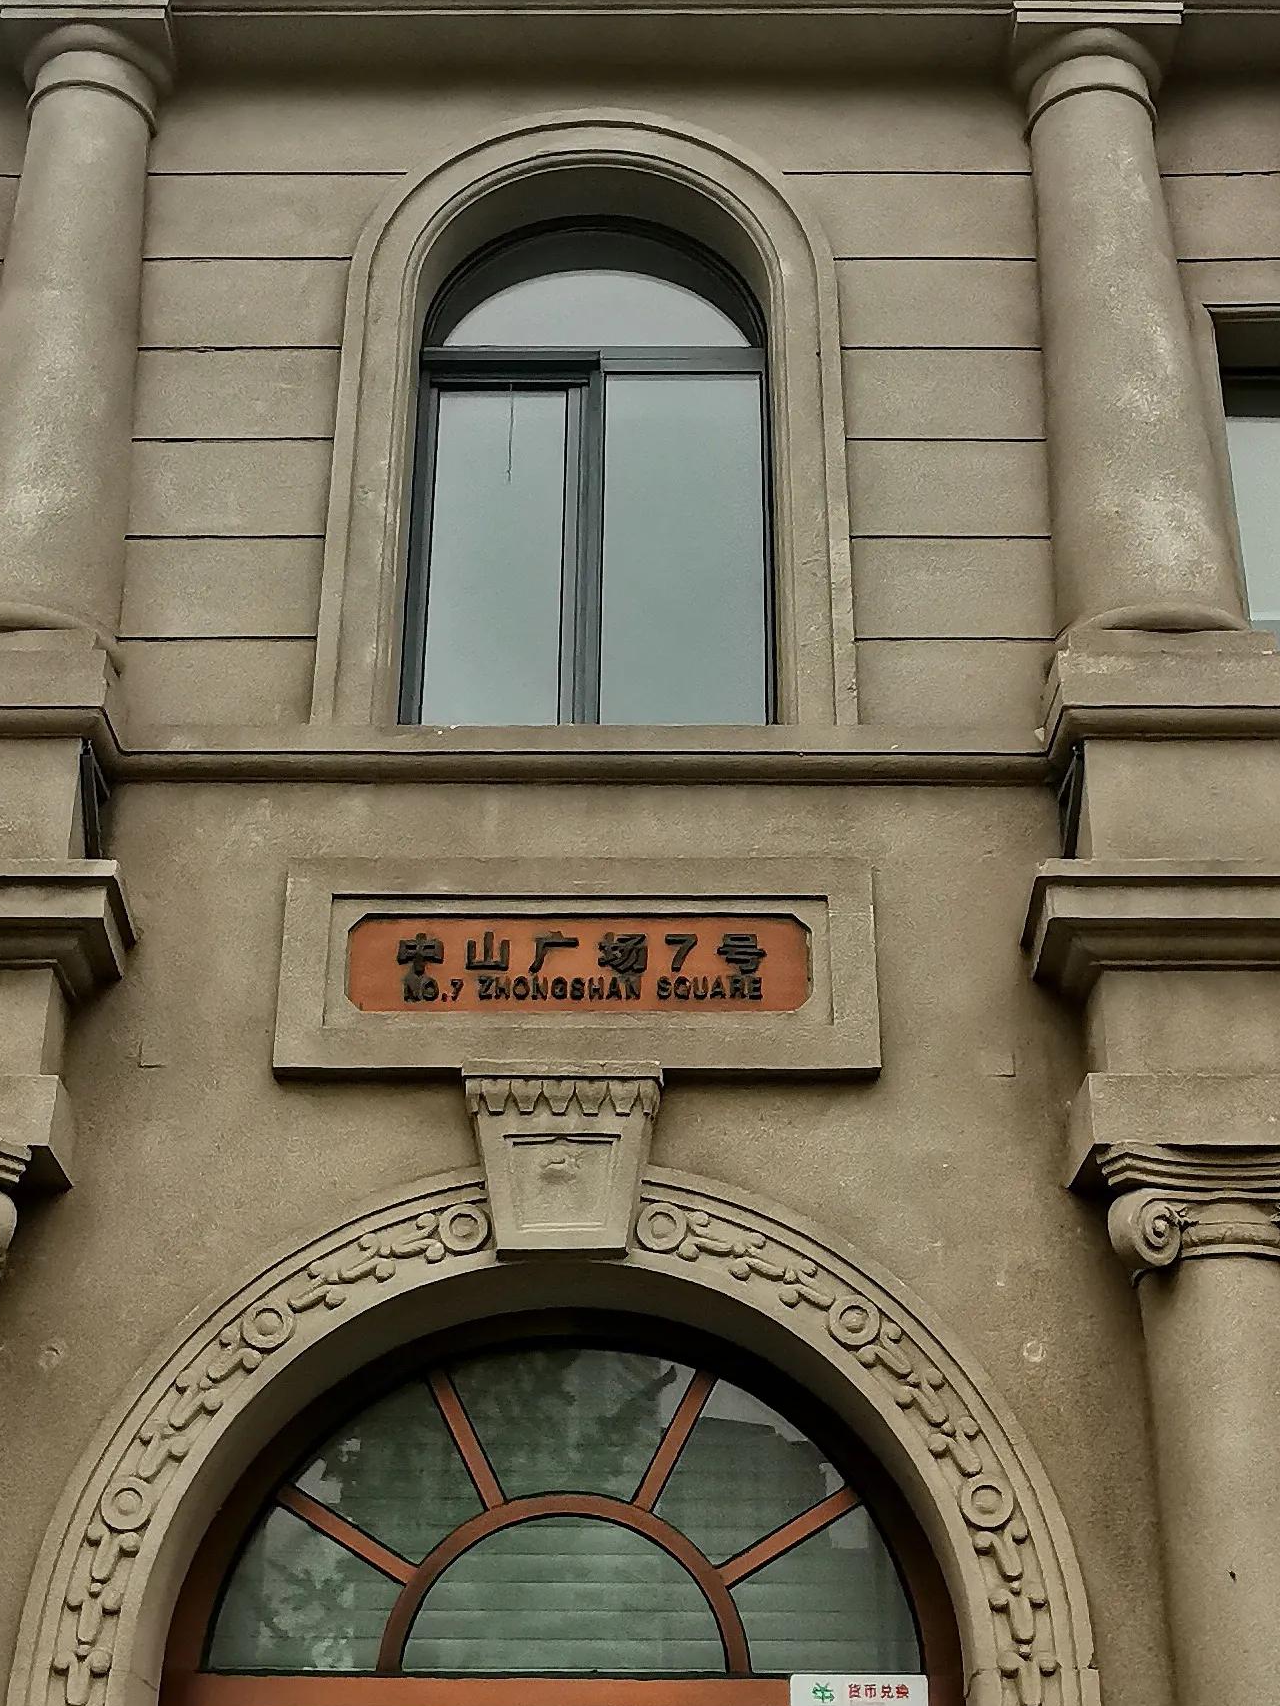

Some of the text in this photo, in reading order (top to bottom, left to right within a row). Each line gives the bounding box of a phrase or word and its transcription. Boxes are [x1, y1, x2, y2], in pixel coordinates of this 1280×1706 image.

[396, 931, 767, 975] 中山广场7号
[477, 976, 642, 1001] ZHONGSHAN
[655, 976, 764, 1001] SQUARE
[848, 1683, 910, 1699] 货币兑换
